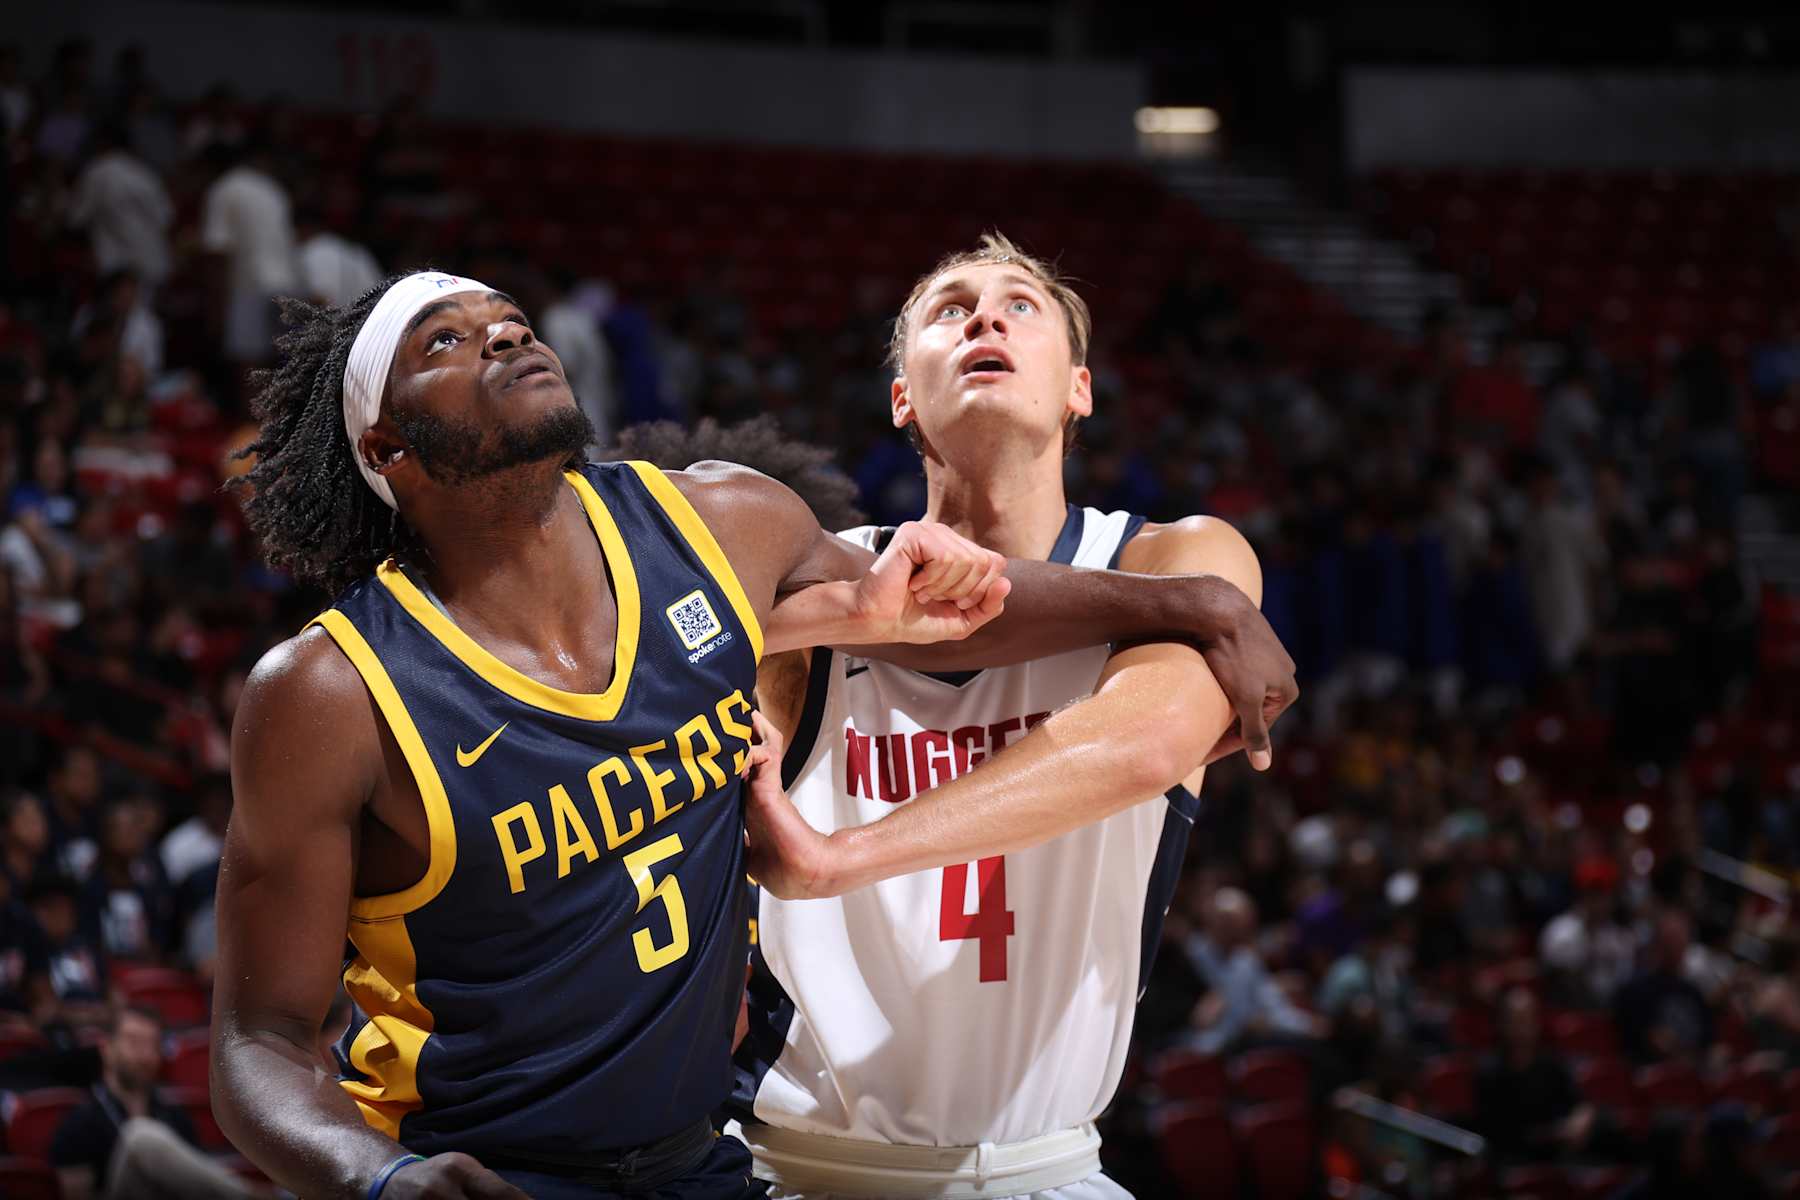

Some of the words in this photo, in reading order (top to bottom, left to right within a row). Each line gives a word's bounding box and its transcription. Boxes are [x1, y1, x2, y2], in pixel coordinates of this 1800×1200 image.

[688, 631, 733, 664] spokenote
[490, 689, 753, 895] PACERS
[845, 710, 1052, 803] NUGG
[622, 832, 690, 974] 5
[939, 855, 1015, 983] 4
